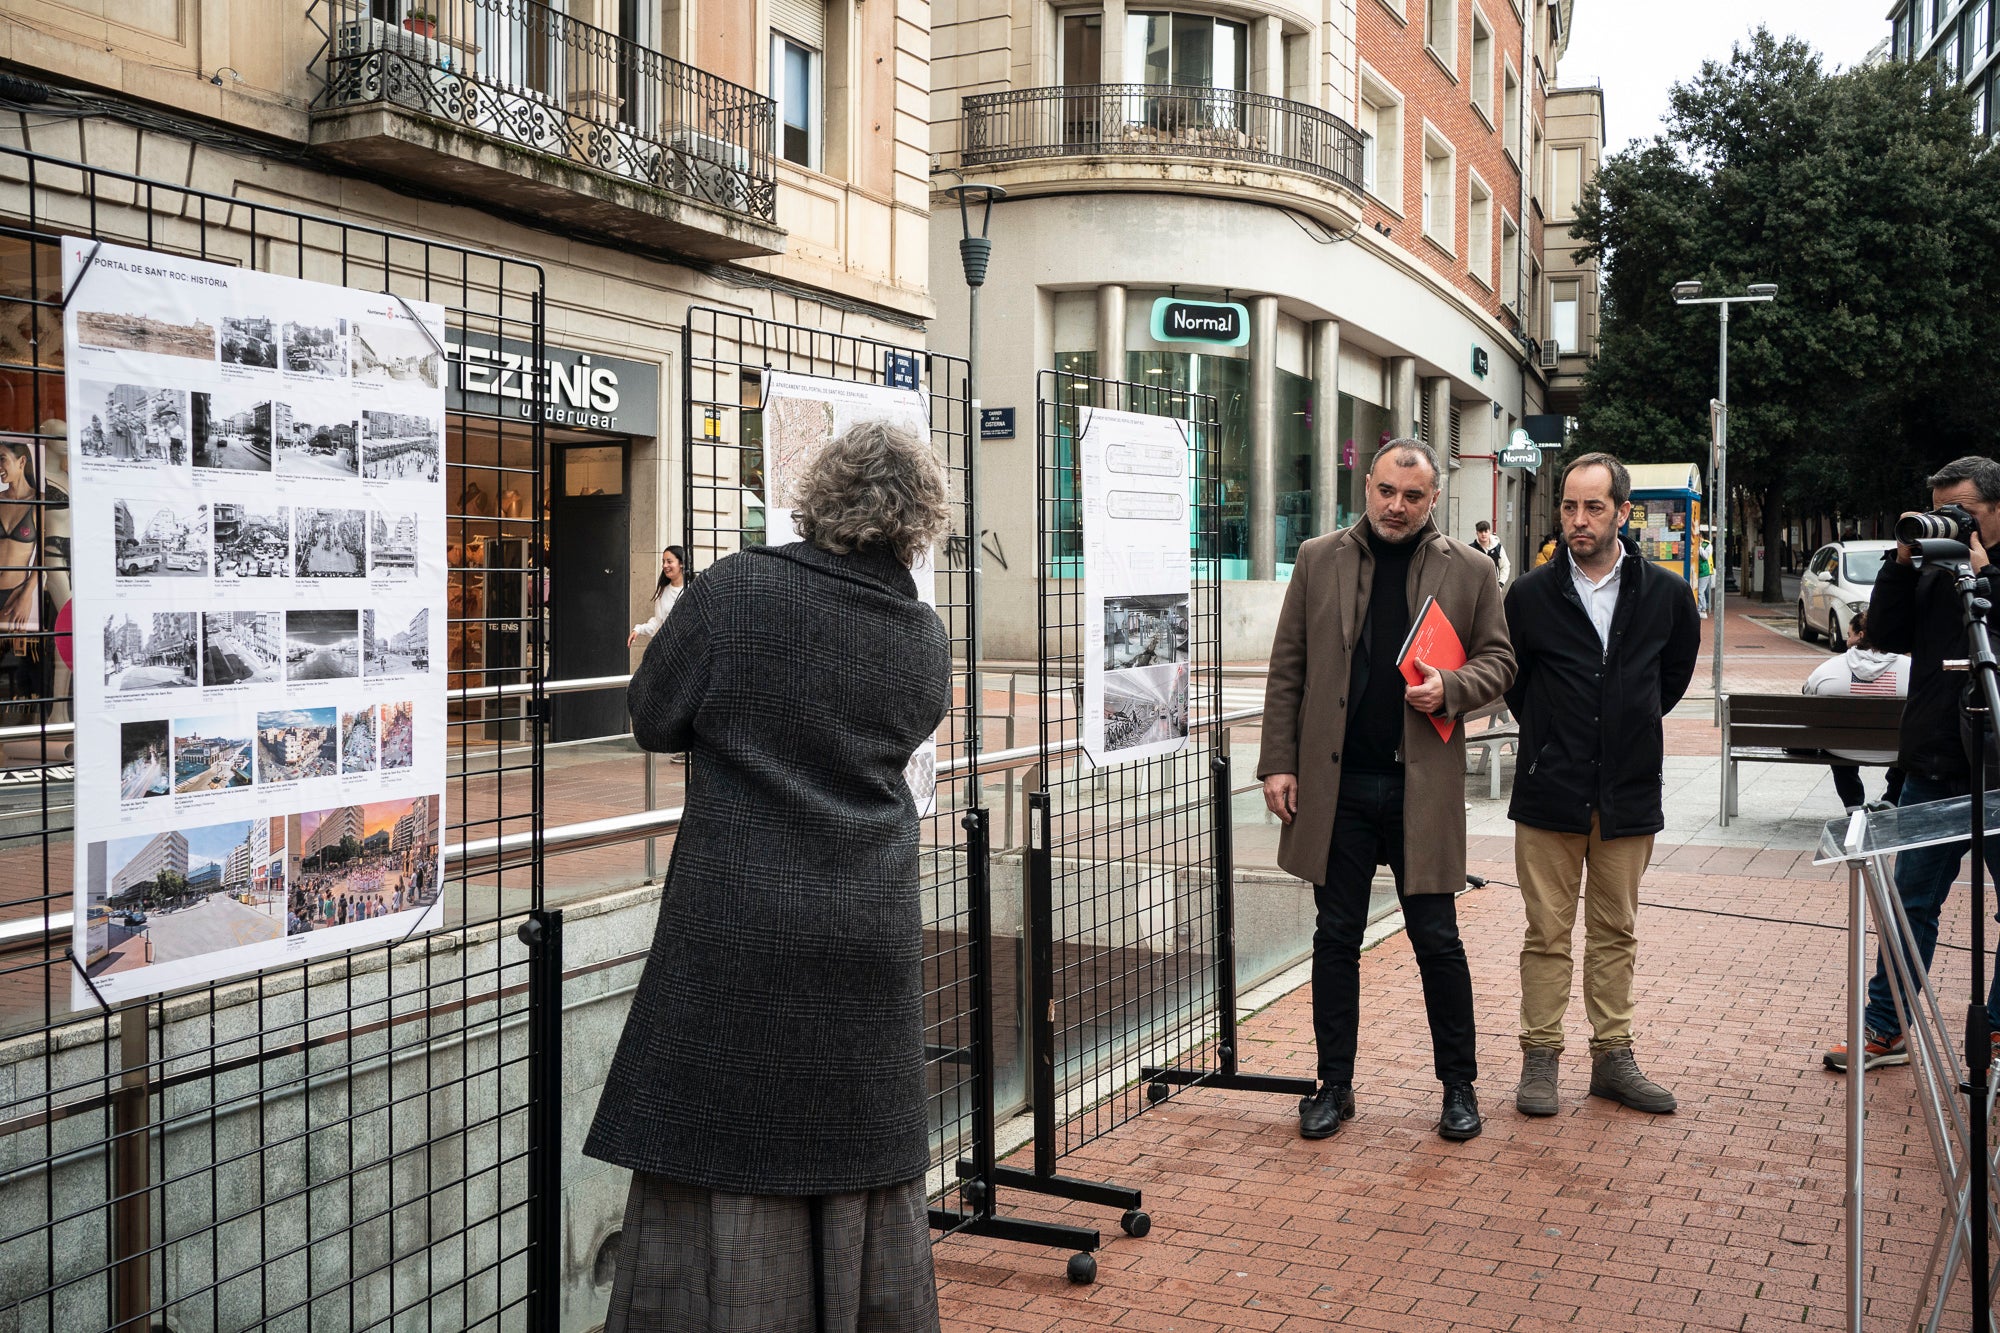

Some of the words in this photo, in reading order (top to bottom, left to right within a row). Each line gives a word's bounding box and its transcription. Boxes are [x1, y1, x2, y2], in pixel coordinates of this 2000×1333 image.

[94, 257, 128, 272] PORTAL
[131, 264, 142, 274] DE
[144, 266, 167, 278] SANT
[170, 270, 188, 282] ROC:
[1174, 309, 1232, 332] Normal
[522, 404, 618, 428] uderwear
[1503, 452, 1536, 463] Normal
[488, 622, 518, 630] TEENIS
